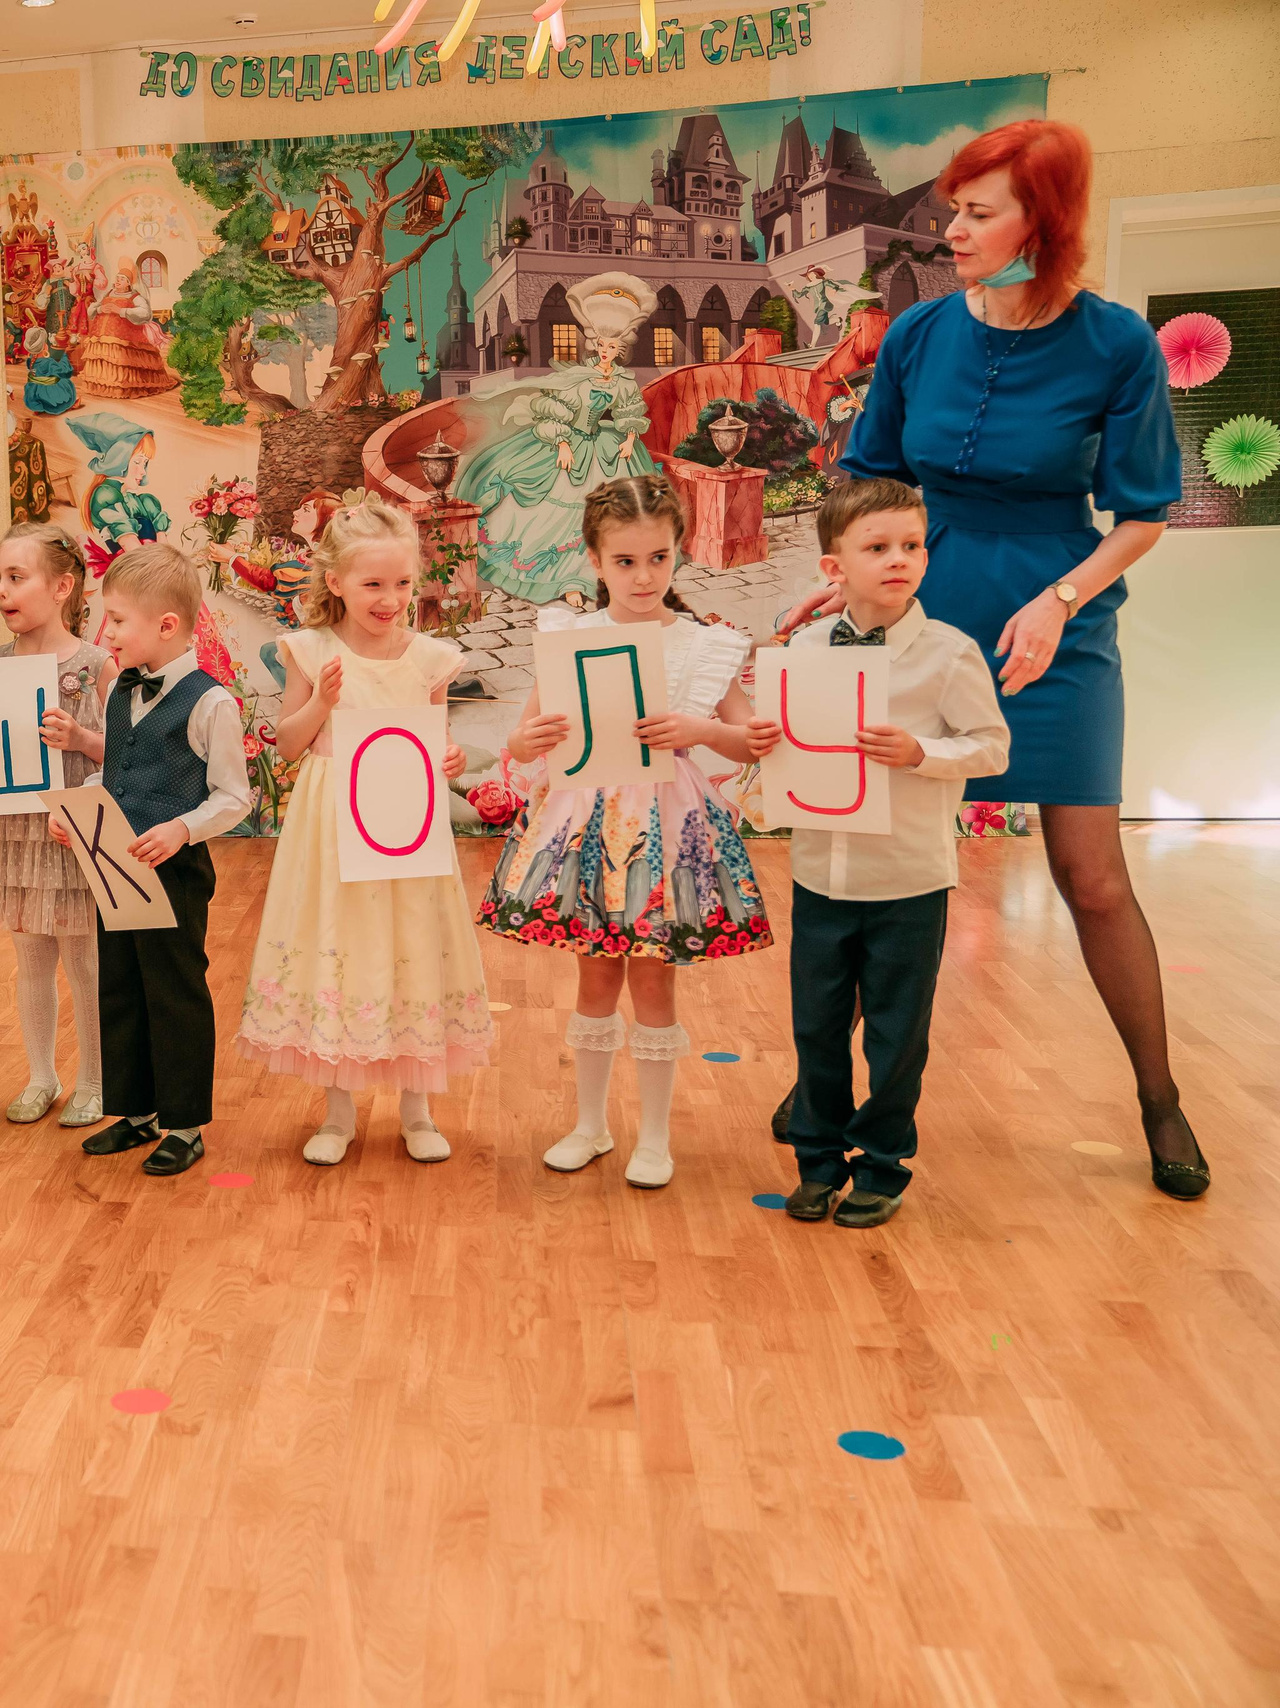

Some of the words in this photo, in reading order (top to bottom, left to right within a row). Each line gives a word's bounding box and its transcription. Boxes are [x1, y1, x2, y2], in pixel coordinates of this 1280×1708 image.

[140, 51, 198, 97] ДО
[211, 40, 441, 102] СВИДАНИЯ
[701, 3, 812, 65] САД!
[564, 644, 651, 777] Л
[781, 668, 866, 817] У
[60, 803, 152, 910] К
[350, 726, 435, 857] О
